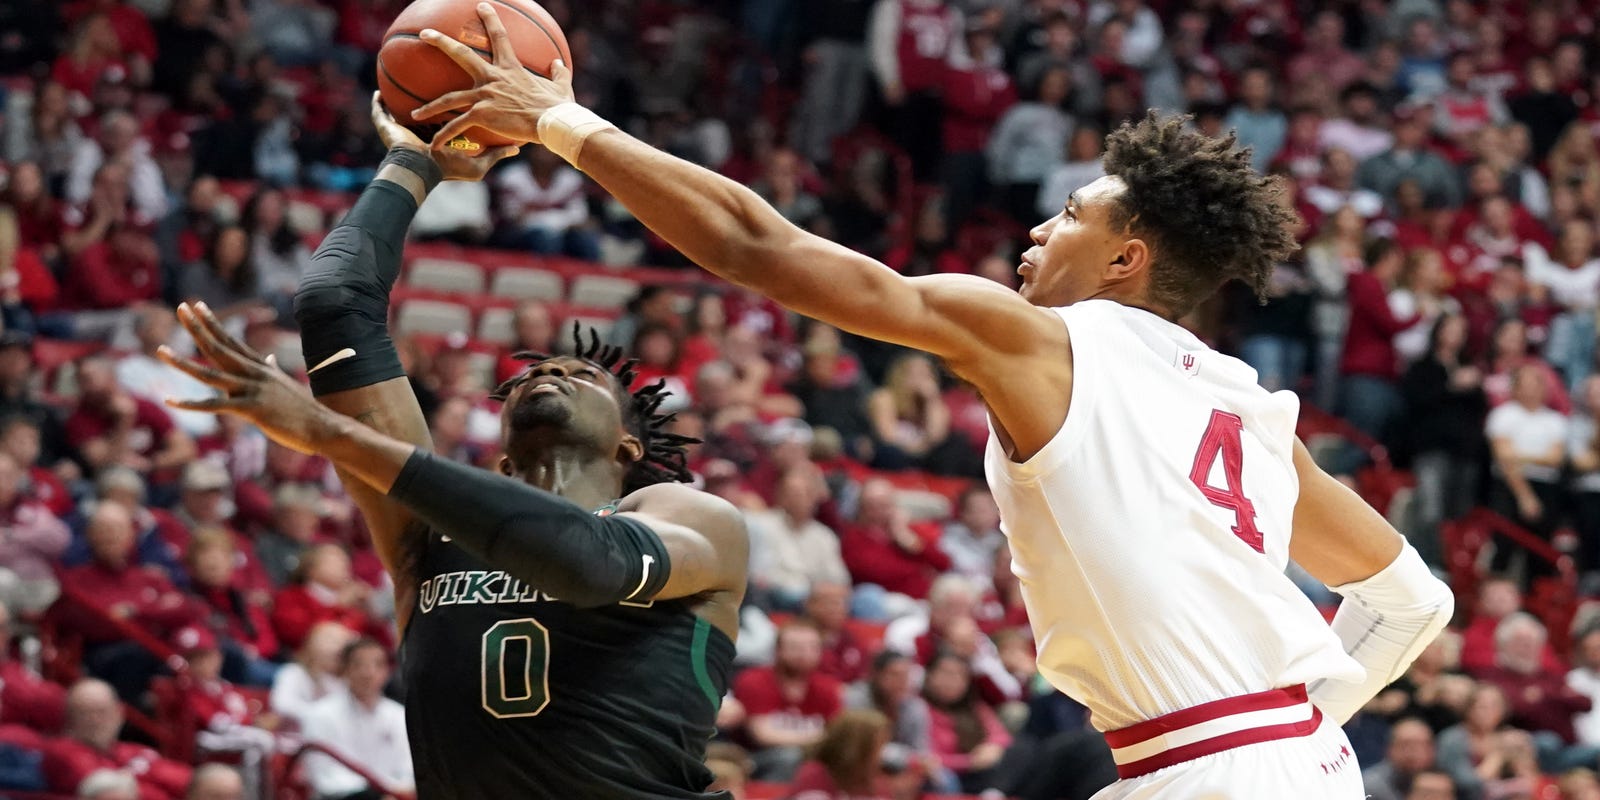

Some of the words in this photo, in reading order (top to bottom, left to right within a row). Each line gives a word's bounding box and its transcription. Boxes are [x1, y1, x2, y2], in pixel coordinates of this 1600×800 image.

[1189, 408, 1265, 554] 4
[420, 570, 653, 614] VIKI
[481, 618, 550, 719] 0
